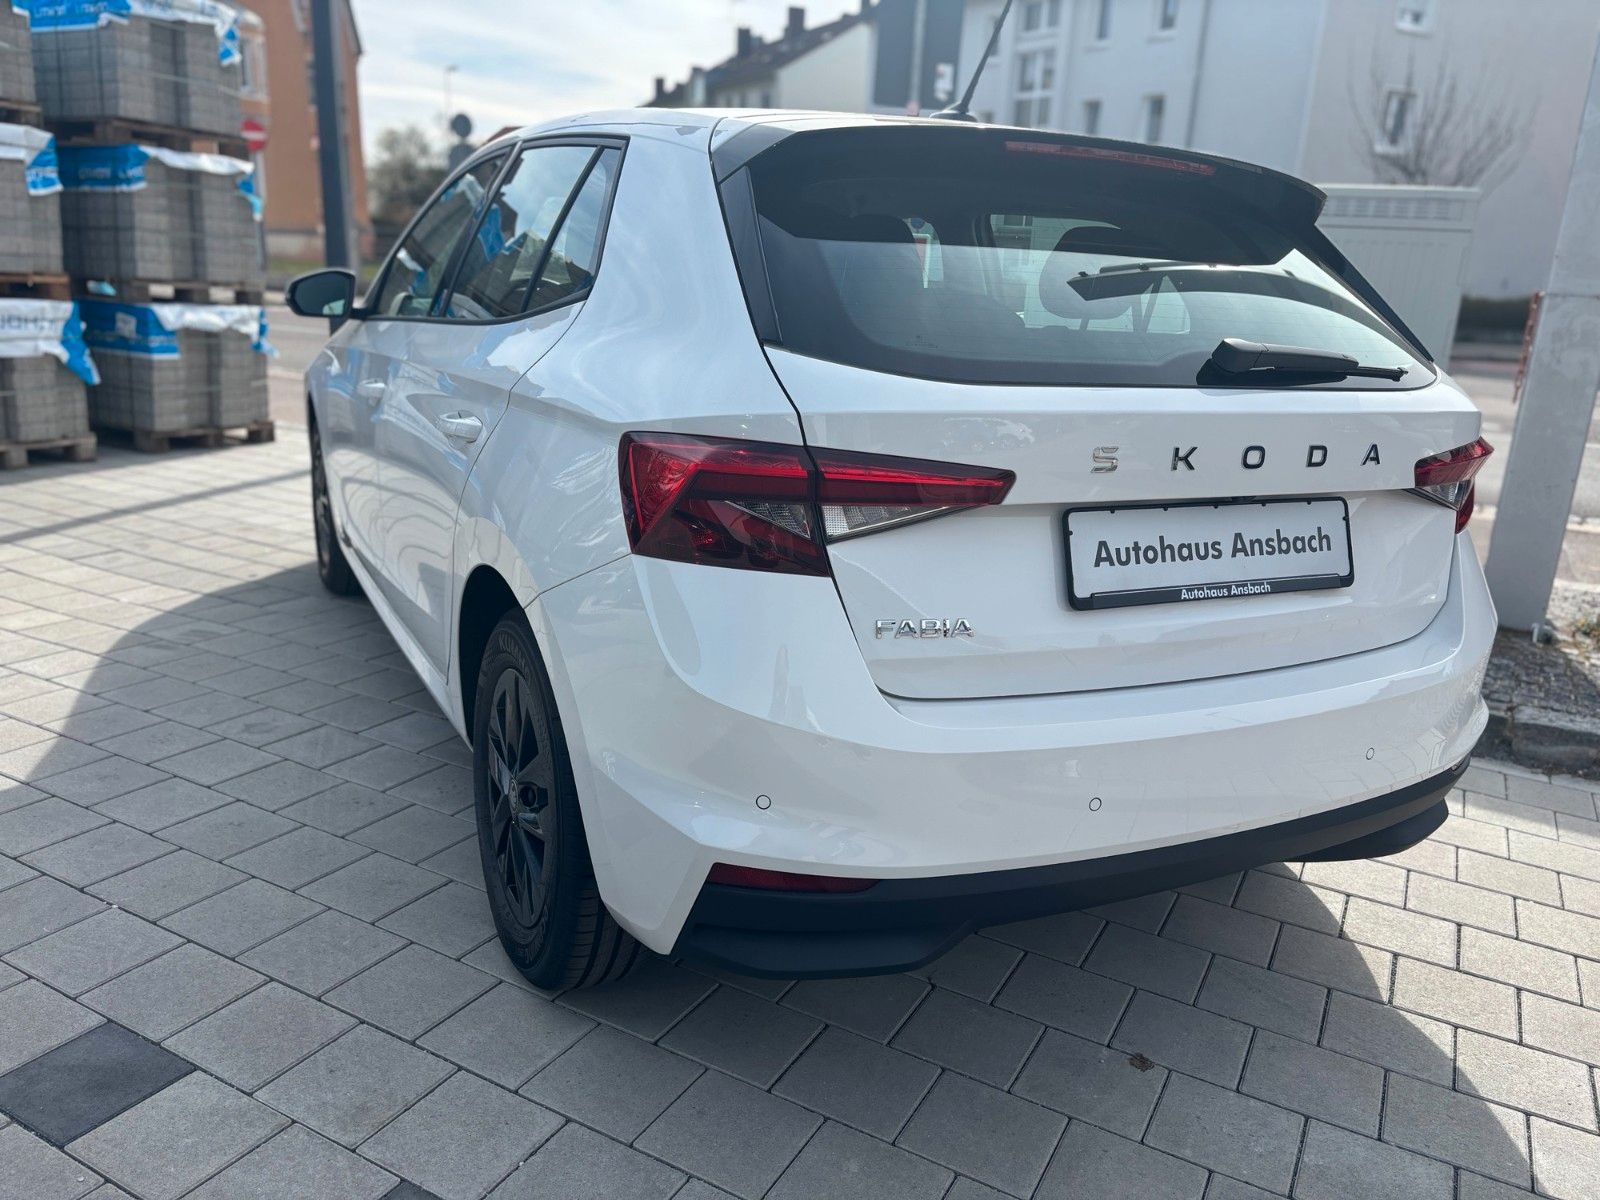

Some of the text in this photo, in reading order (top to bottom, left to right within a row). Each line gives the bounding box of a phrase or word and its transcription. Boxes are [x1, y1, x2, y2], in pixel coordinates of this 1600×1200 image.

[1090, 443, 1382, 474] SKODA
[1093, 526, 1332, 567] Autohaus Ansbach
[1181, 582, 1271, 600] Autohaus Ansbach
[875, 617, 975, 639] FABIA
